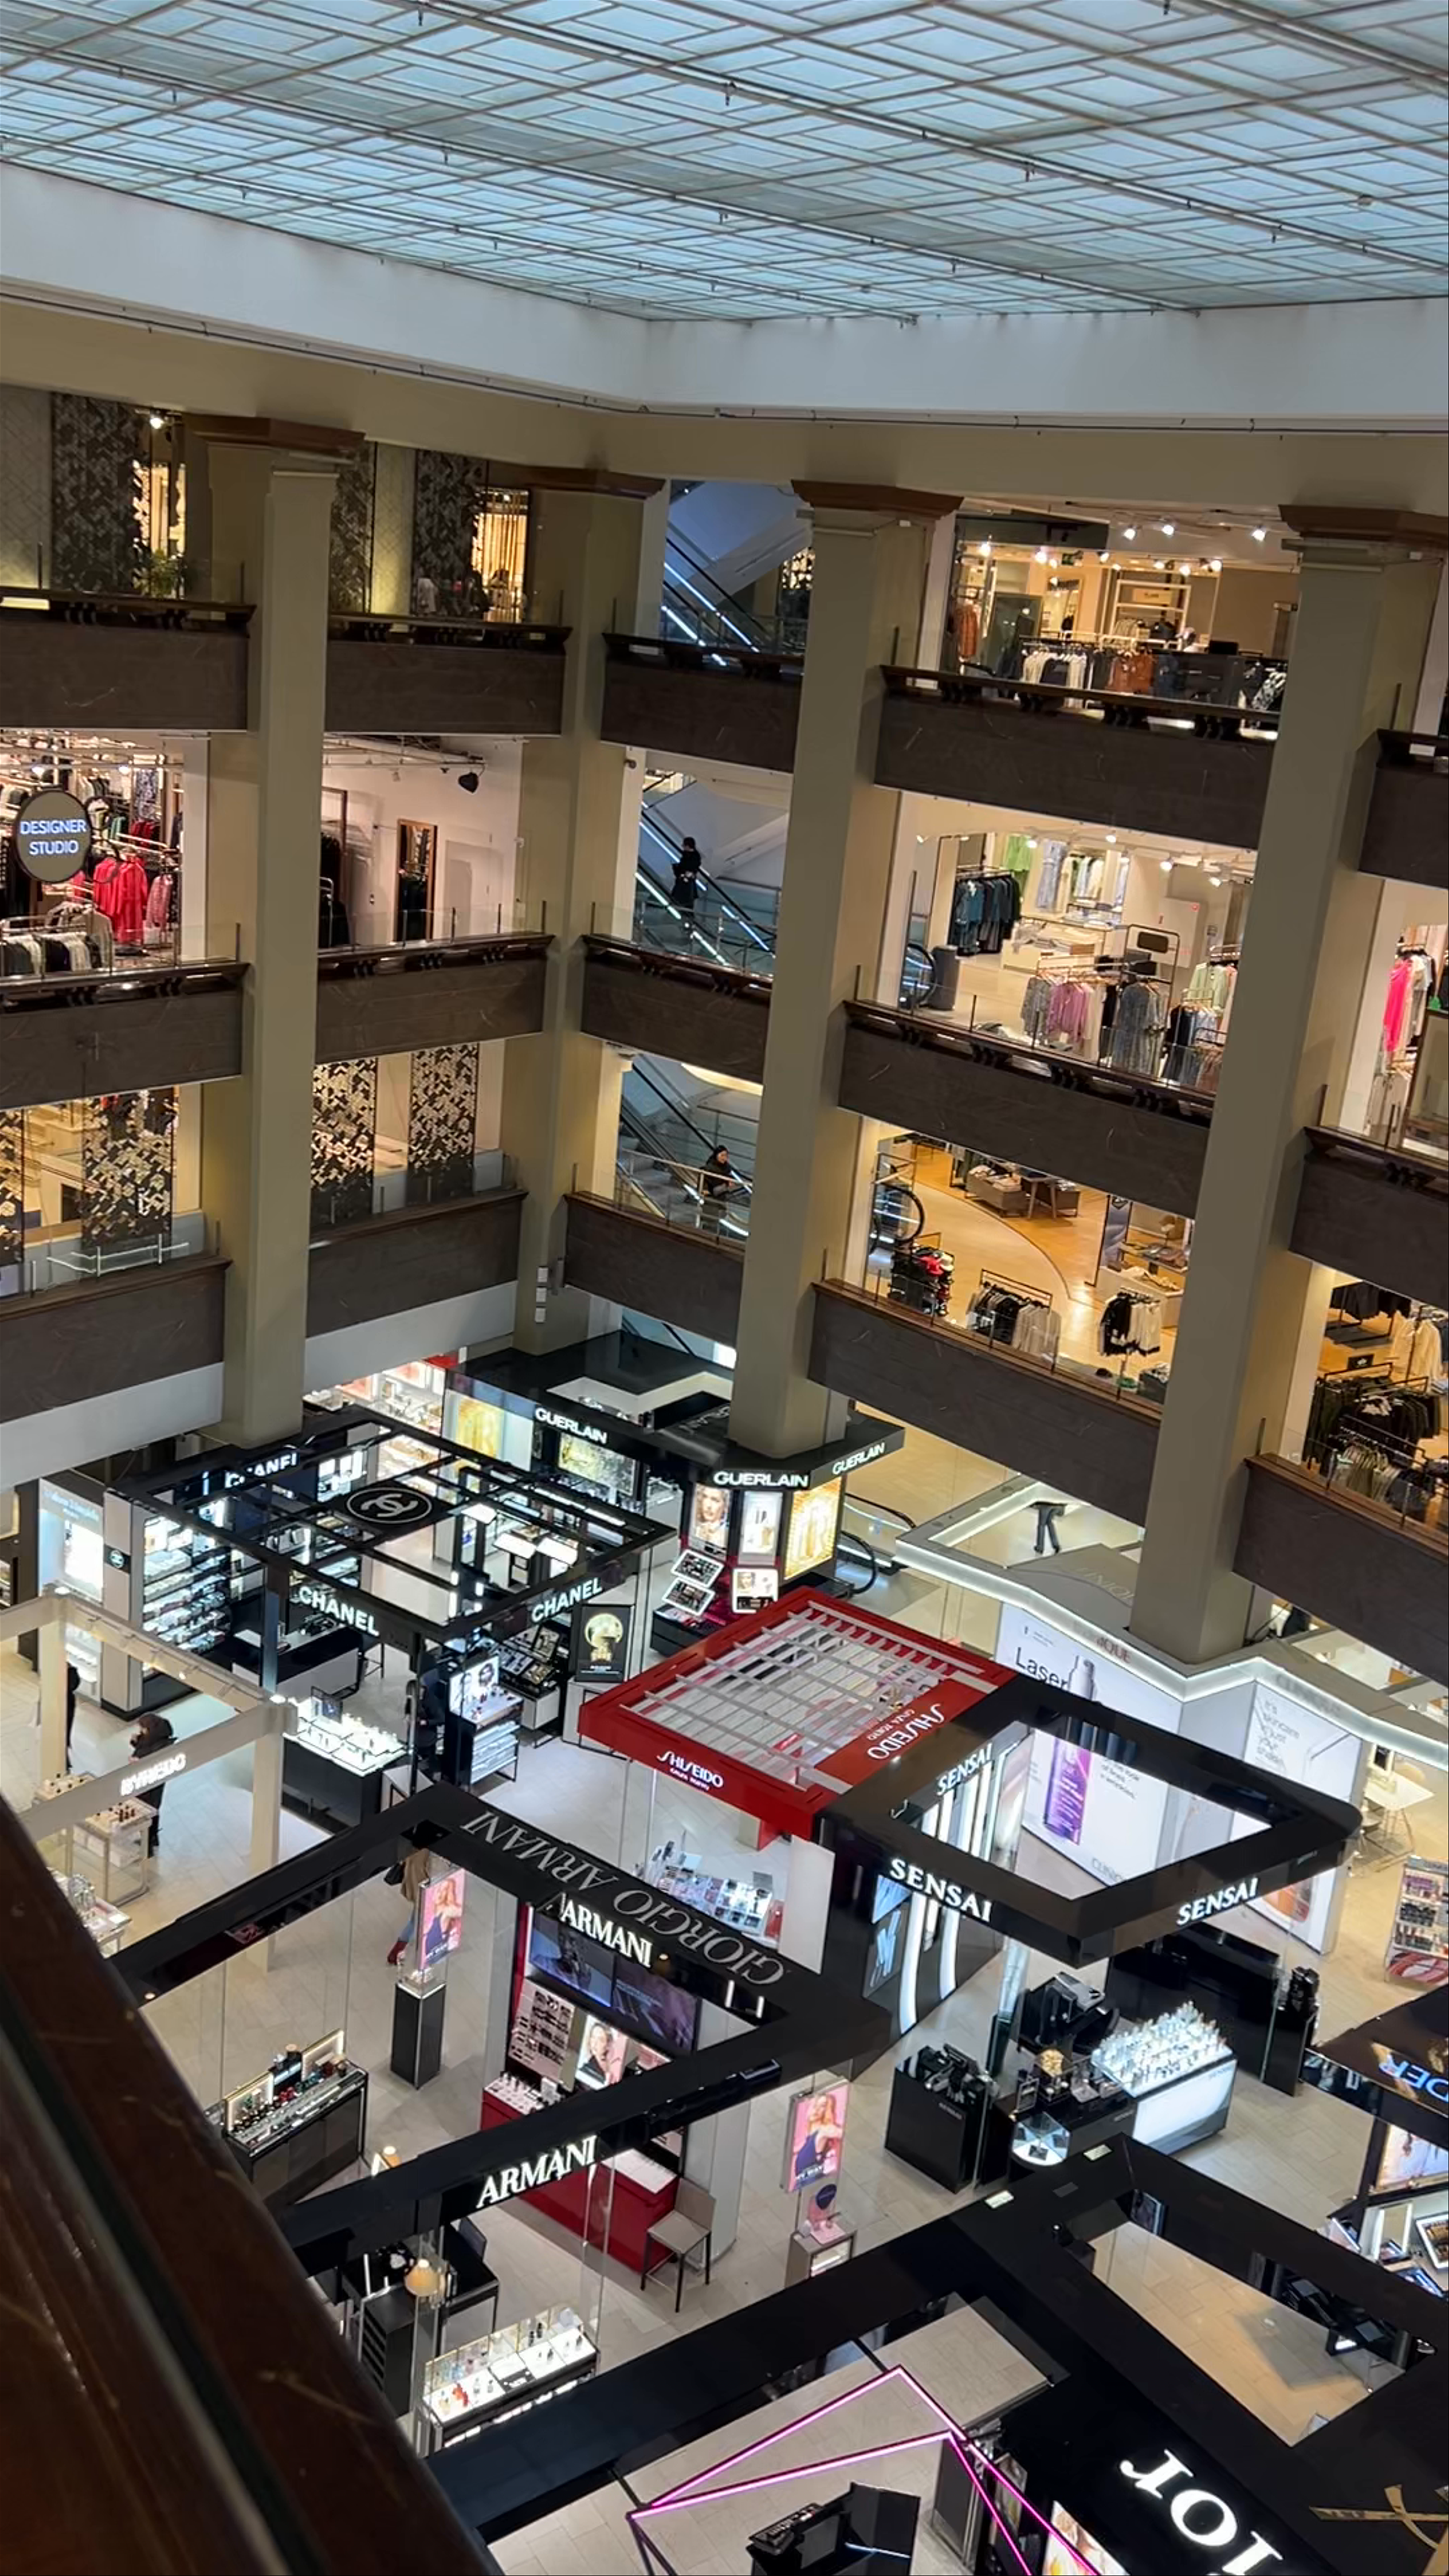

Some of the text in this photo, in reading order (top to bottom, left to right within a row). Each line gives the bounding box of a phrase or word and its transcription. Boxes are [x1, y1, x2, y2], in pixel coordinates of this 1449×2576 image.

[20, 819, 87, 835] DESIGNER
[29, 840, 78, 856] STUDIO
[535, 1407, 607, 1444] GUERLAIN
[713, 1470, 809, 1487] GUERLAIN
[832, 1443, 885, 1475] GUERLAIN
[298, 1586, 380, 1636] CHANEL
[531, 1577, 602, 1622] CHANEL
[1016, 1647, 1068, 1689] Laser
[867, 1703, 944, 1759] SHISEIDO
[657, 1751, 723, 1788] SHISEIDO
[937, 1743, 992, 1796] SENSAI
[459, 1811, 784, 1985] GIORGIO ARMANI
[889, 1858, 992, 1923] SENSAI
[1177, 1878, 1259, 1925] SENSAI
[560, 1899, 652, 1967] ARMANI
[475, 2135, 597, 2208] ARMANI
